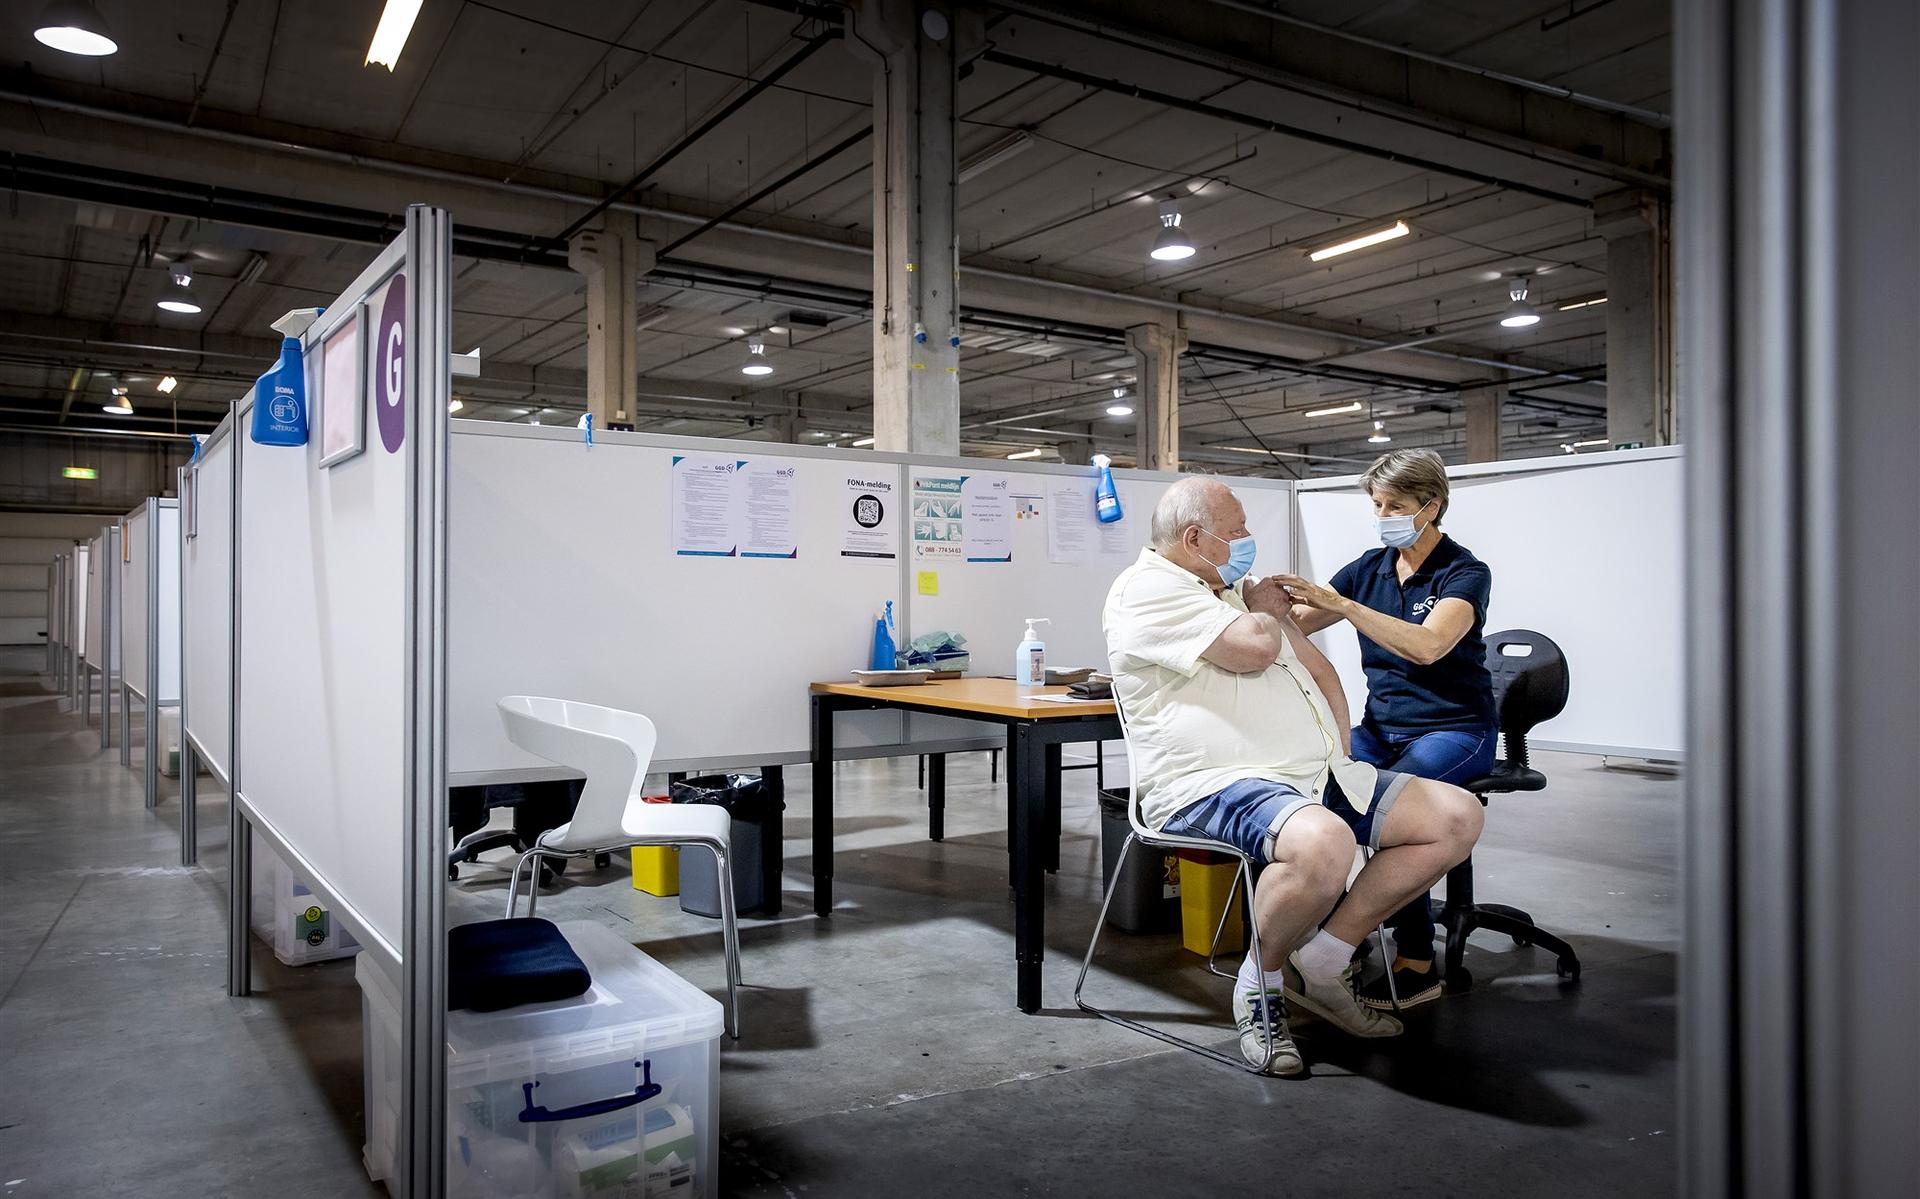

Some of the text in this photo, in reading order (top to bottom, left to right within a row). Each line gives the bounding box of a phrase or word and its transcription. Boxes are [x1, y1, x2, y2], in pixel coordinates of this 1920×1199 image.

[386, 321, 402, 407] G
[275, 386, 295, 395] BOMA
[270, 424, 299, 433] INTERIOR
[847, 479, 892, 491] FONA-melding
